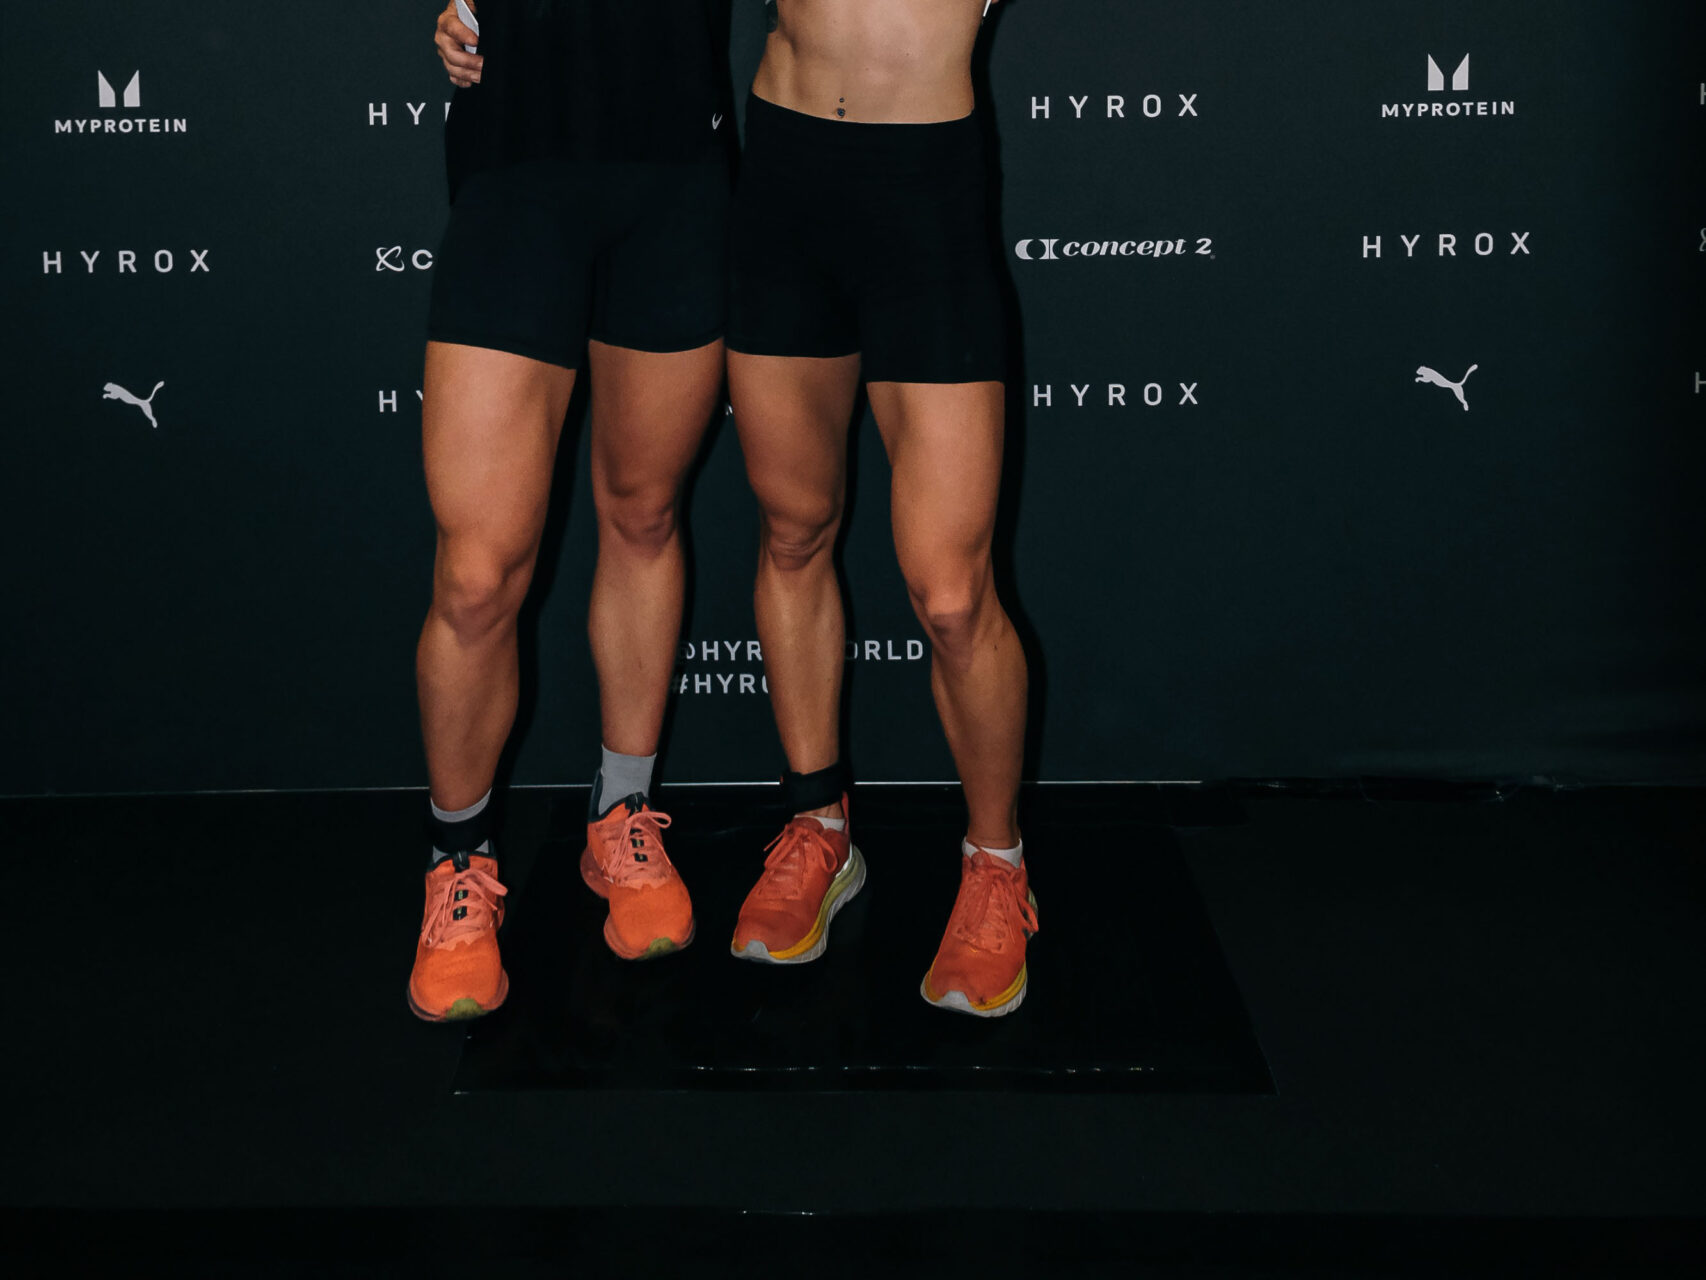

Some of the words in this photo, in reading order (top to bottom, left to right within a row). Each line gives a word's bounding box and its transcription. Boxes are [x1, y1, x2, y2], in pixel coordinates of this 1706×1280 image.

[1031, 93, 1198, 120] HYROX
[1381, 100, 1515, 118] MYPROTEIN
[54, 118, 187, 134] MYPROTEIN
[1062, 238, 1187, 258] concept
[1362, 231, 1531, 259] HYROX
[42, 249, 210, 274] HYROX
[1033, 382, 1198, 407] HYROX
